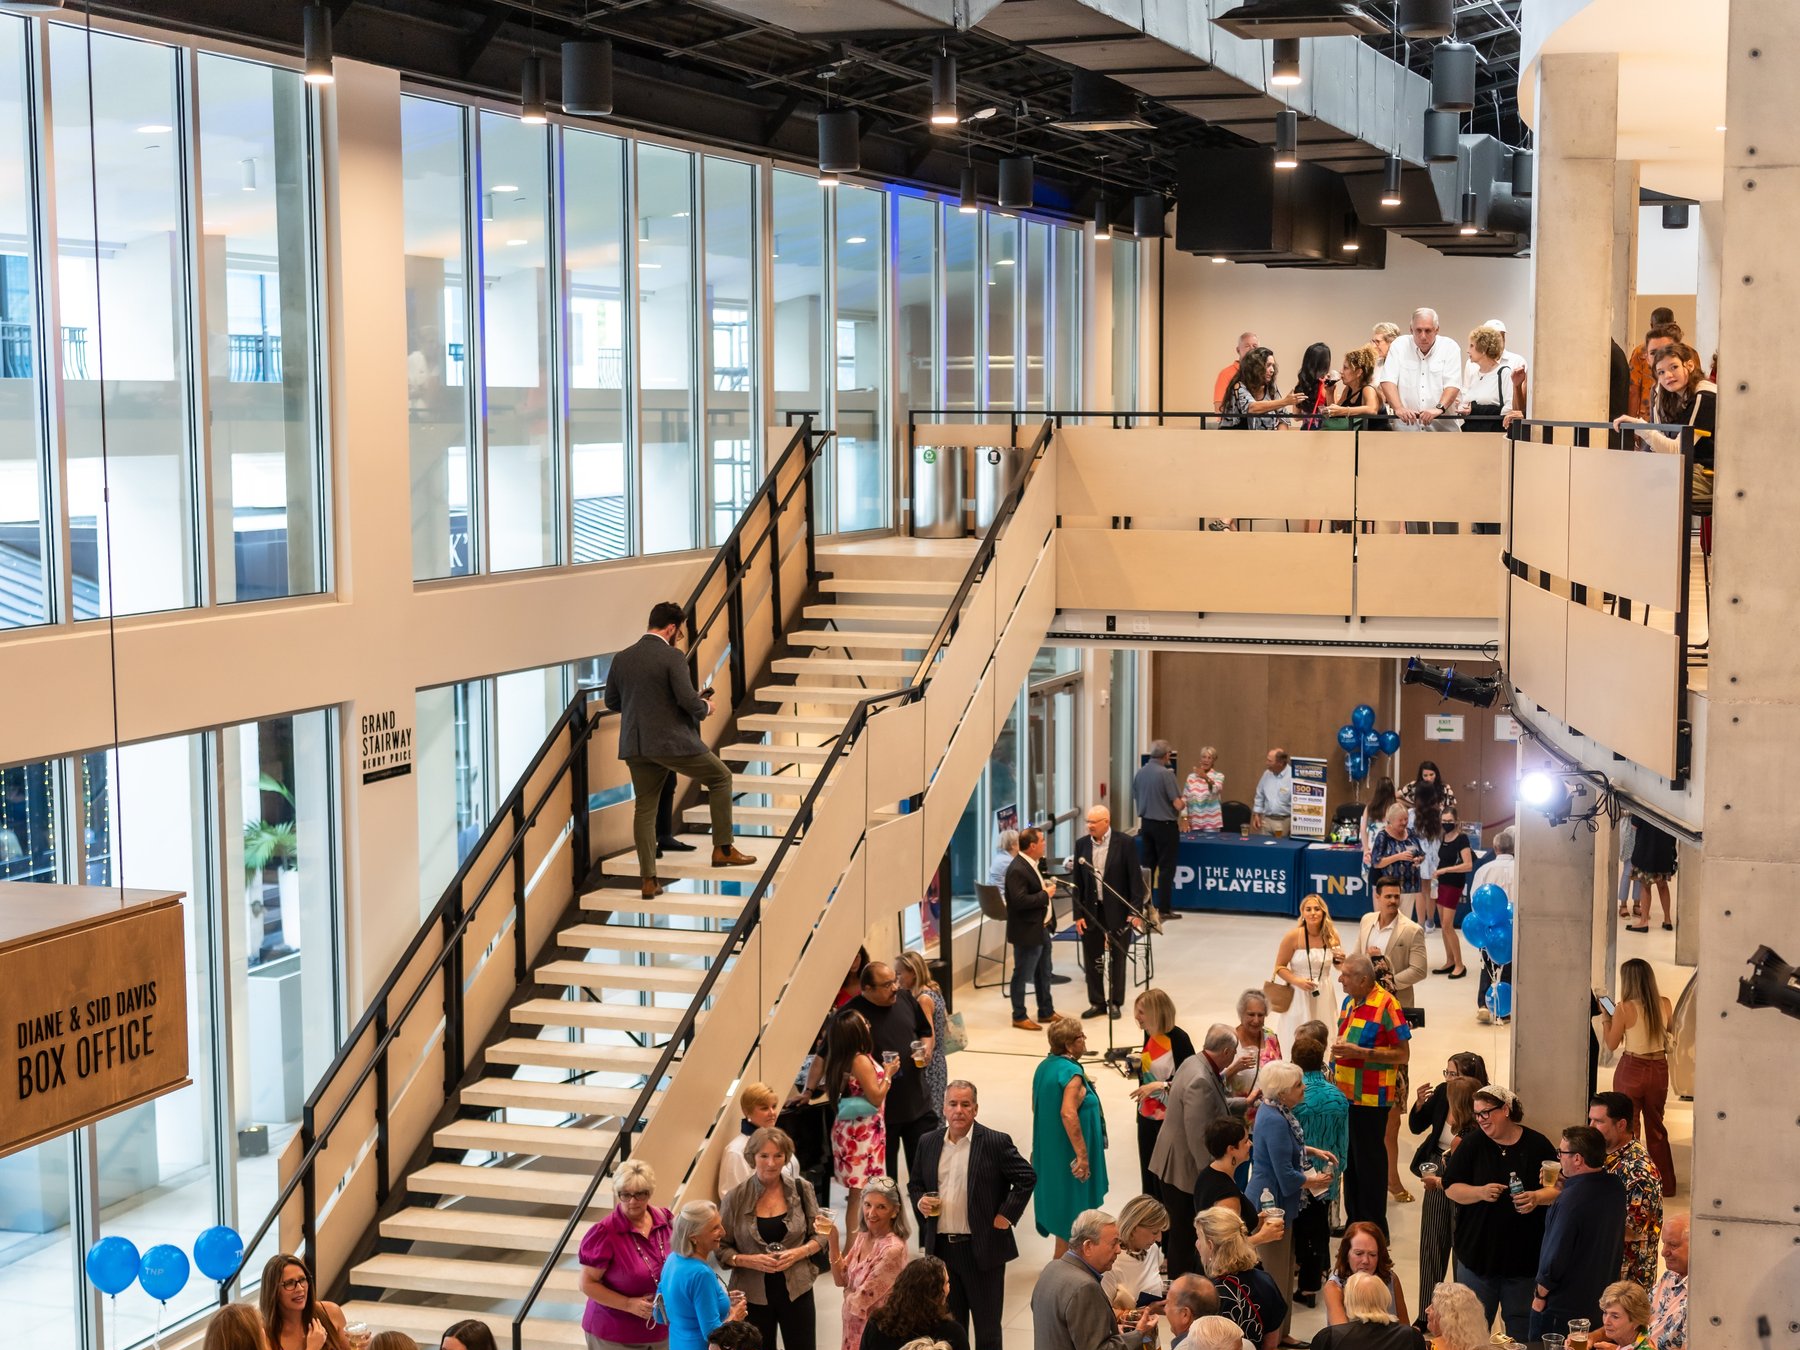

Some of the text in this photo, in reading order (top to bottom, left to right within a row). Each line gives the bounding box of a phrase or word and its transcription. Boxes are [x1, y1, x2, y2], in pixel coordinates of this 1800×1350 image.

[361, 710, 396, 735] GRAND
[362, 727, 412, 757] STAIRWAY
[362, 749, 411, 770] HENRY PRICE
[1296, 785, 1311, 793] 500
[1205, 866, 1229, 878] THE
[1236, 867, 1286, 881] NAPLES
[1310, 873, 1363, 896] TNP
[1205, 879, 1287, 895] PLAYERS
[17, 981, 157, 1049] DIANE & SID DAVIS
[17, 1014, 154, 1100] BOX OFFICE
[145, 1267, 164, 1276] TNP
